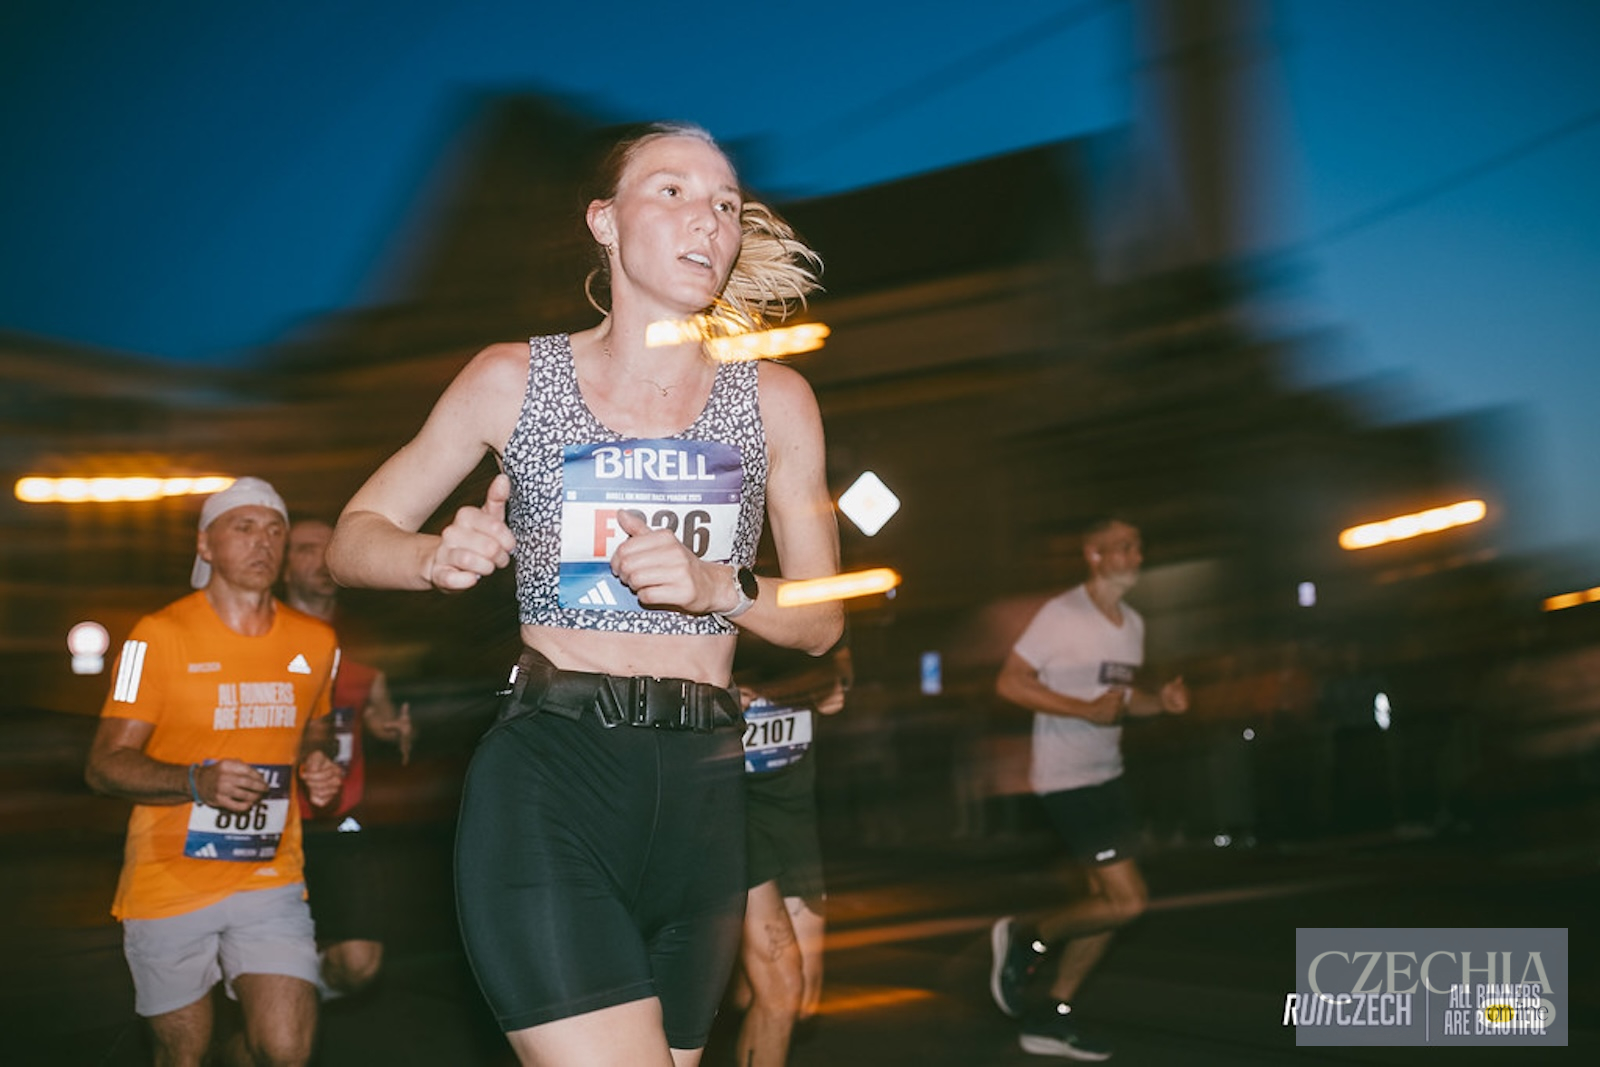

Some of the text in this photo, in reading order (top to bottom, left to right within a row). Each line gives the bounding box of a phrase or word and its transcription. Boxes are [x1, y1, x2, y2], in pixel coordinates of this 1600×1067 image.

[218, 683, 237, 707] ALL
[213, 706, 237, 731] ARE
[745, 716, 796, 748] 2107
